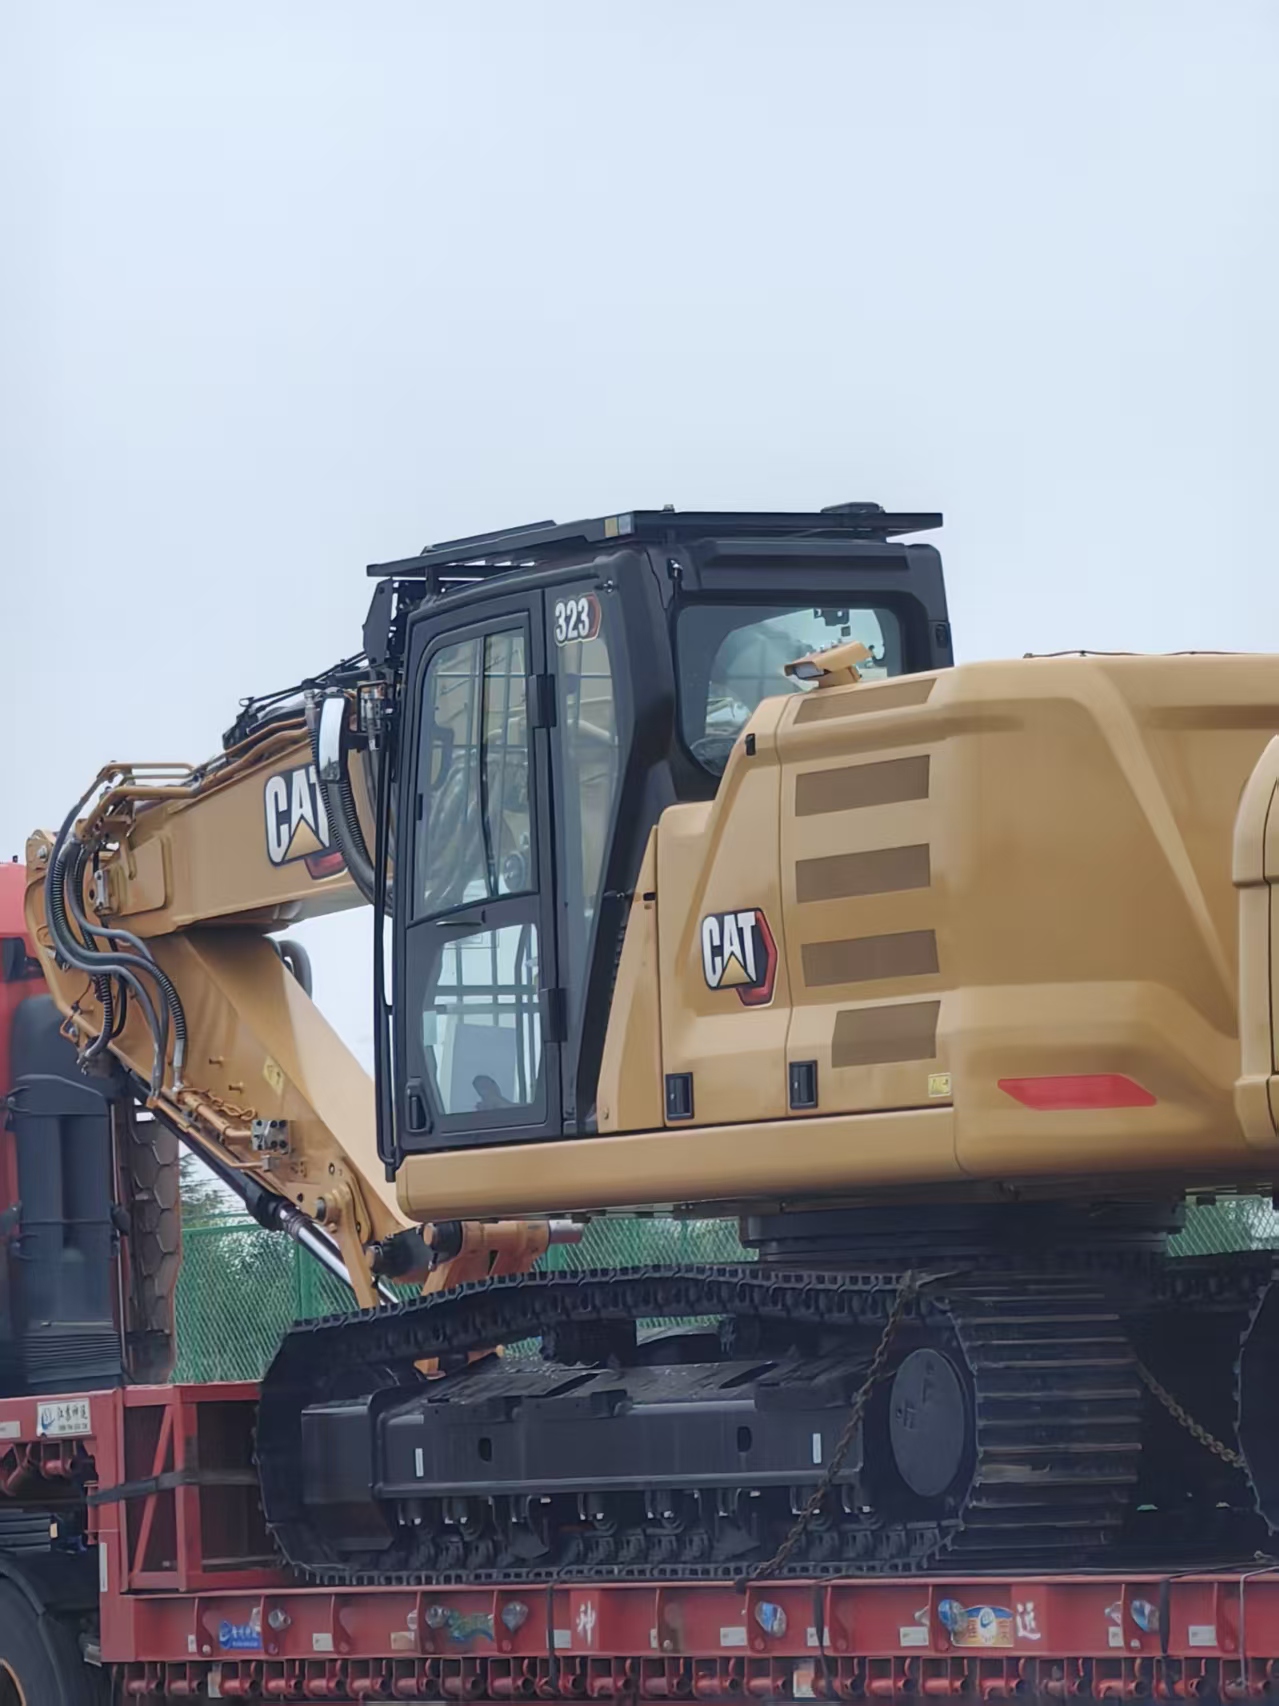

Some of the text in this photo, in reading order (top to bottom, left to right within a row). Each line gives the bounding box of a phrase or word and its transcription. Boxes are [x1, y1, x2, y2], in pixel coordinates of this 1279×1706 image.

[555, 597, 590, 641] 323
[265, 765, 330, 862] CAT
[702, 911, 757, 988] CAT
